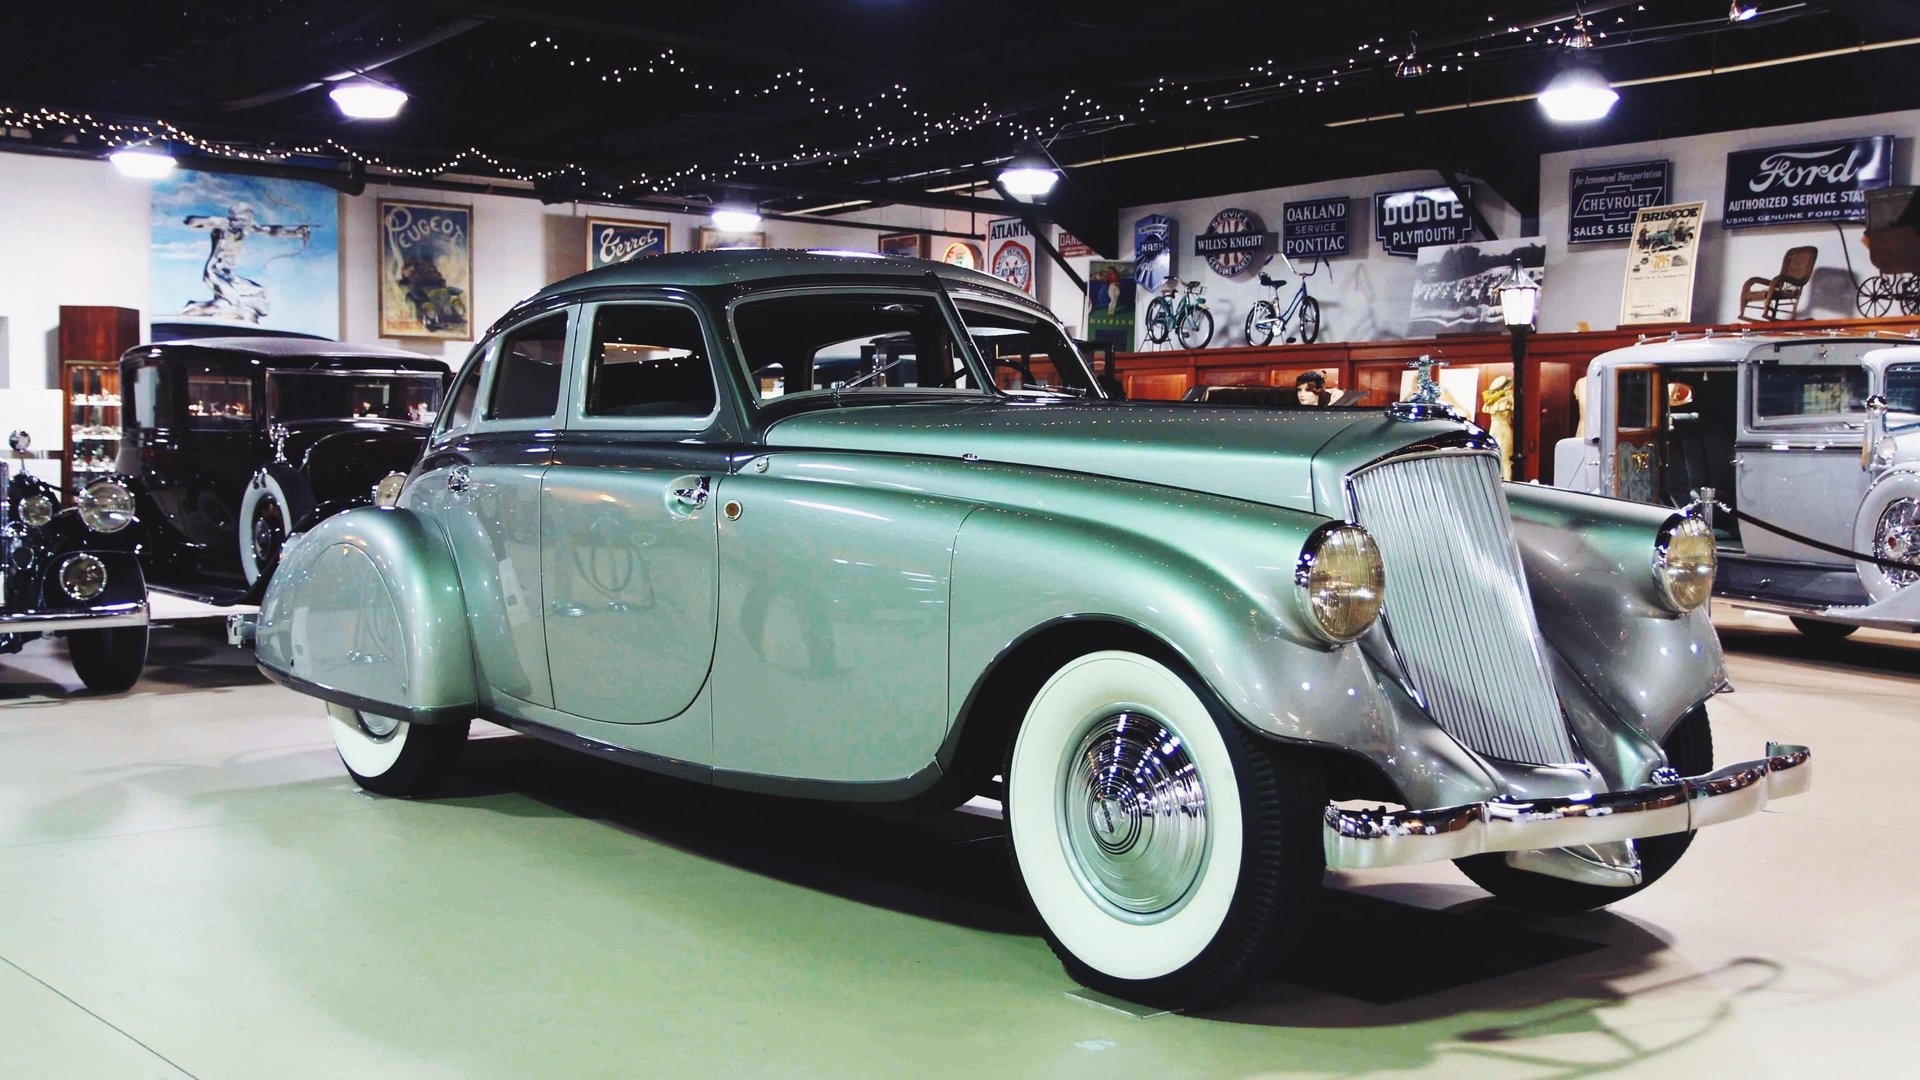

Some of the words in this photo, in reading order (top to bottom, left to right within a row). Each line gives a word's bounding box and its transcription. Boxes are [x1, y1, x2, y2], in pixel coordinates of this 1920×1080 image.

[1749, 145, 1860, 192] Ford
[1582, 194, 1652, 211] CHEVROLET
[1728, 196, 1788, 212] AUTHORIZED
[1792, 192, 1836, 206] SERVICE
[1287, 203, 1345, 221] OAKLAND
[1383, 198, 1464, 226] DODGE
[1640, 207, 1699, 222] BRISCOE
[1726, 216, 1754, 225] USING
[1757, 212, 1803, 222] GENUINE
[1808, 210, 1840, 218] FORD
[1295, 223, 1336, 234] SERVICE
[1393, 226, 1455, 245] PLYMOUTH
[1574, 225, 1603, 237] SALES
[1607, 224, 1614, 234] &
[1141, 243, 1164, 252] NASH
[1198, 238, 1228, 250] WILLYS
[1230, 235, 1263, 248] KNIGHT
[1287, 236, 1345, 253] PONTIAC
